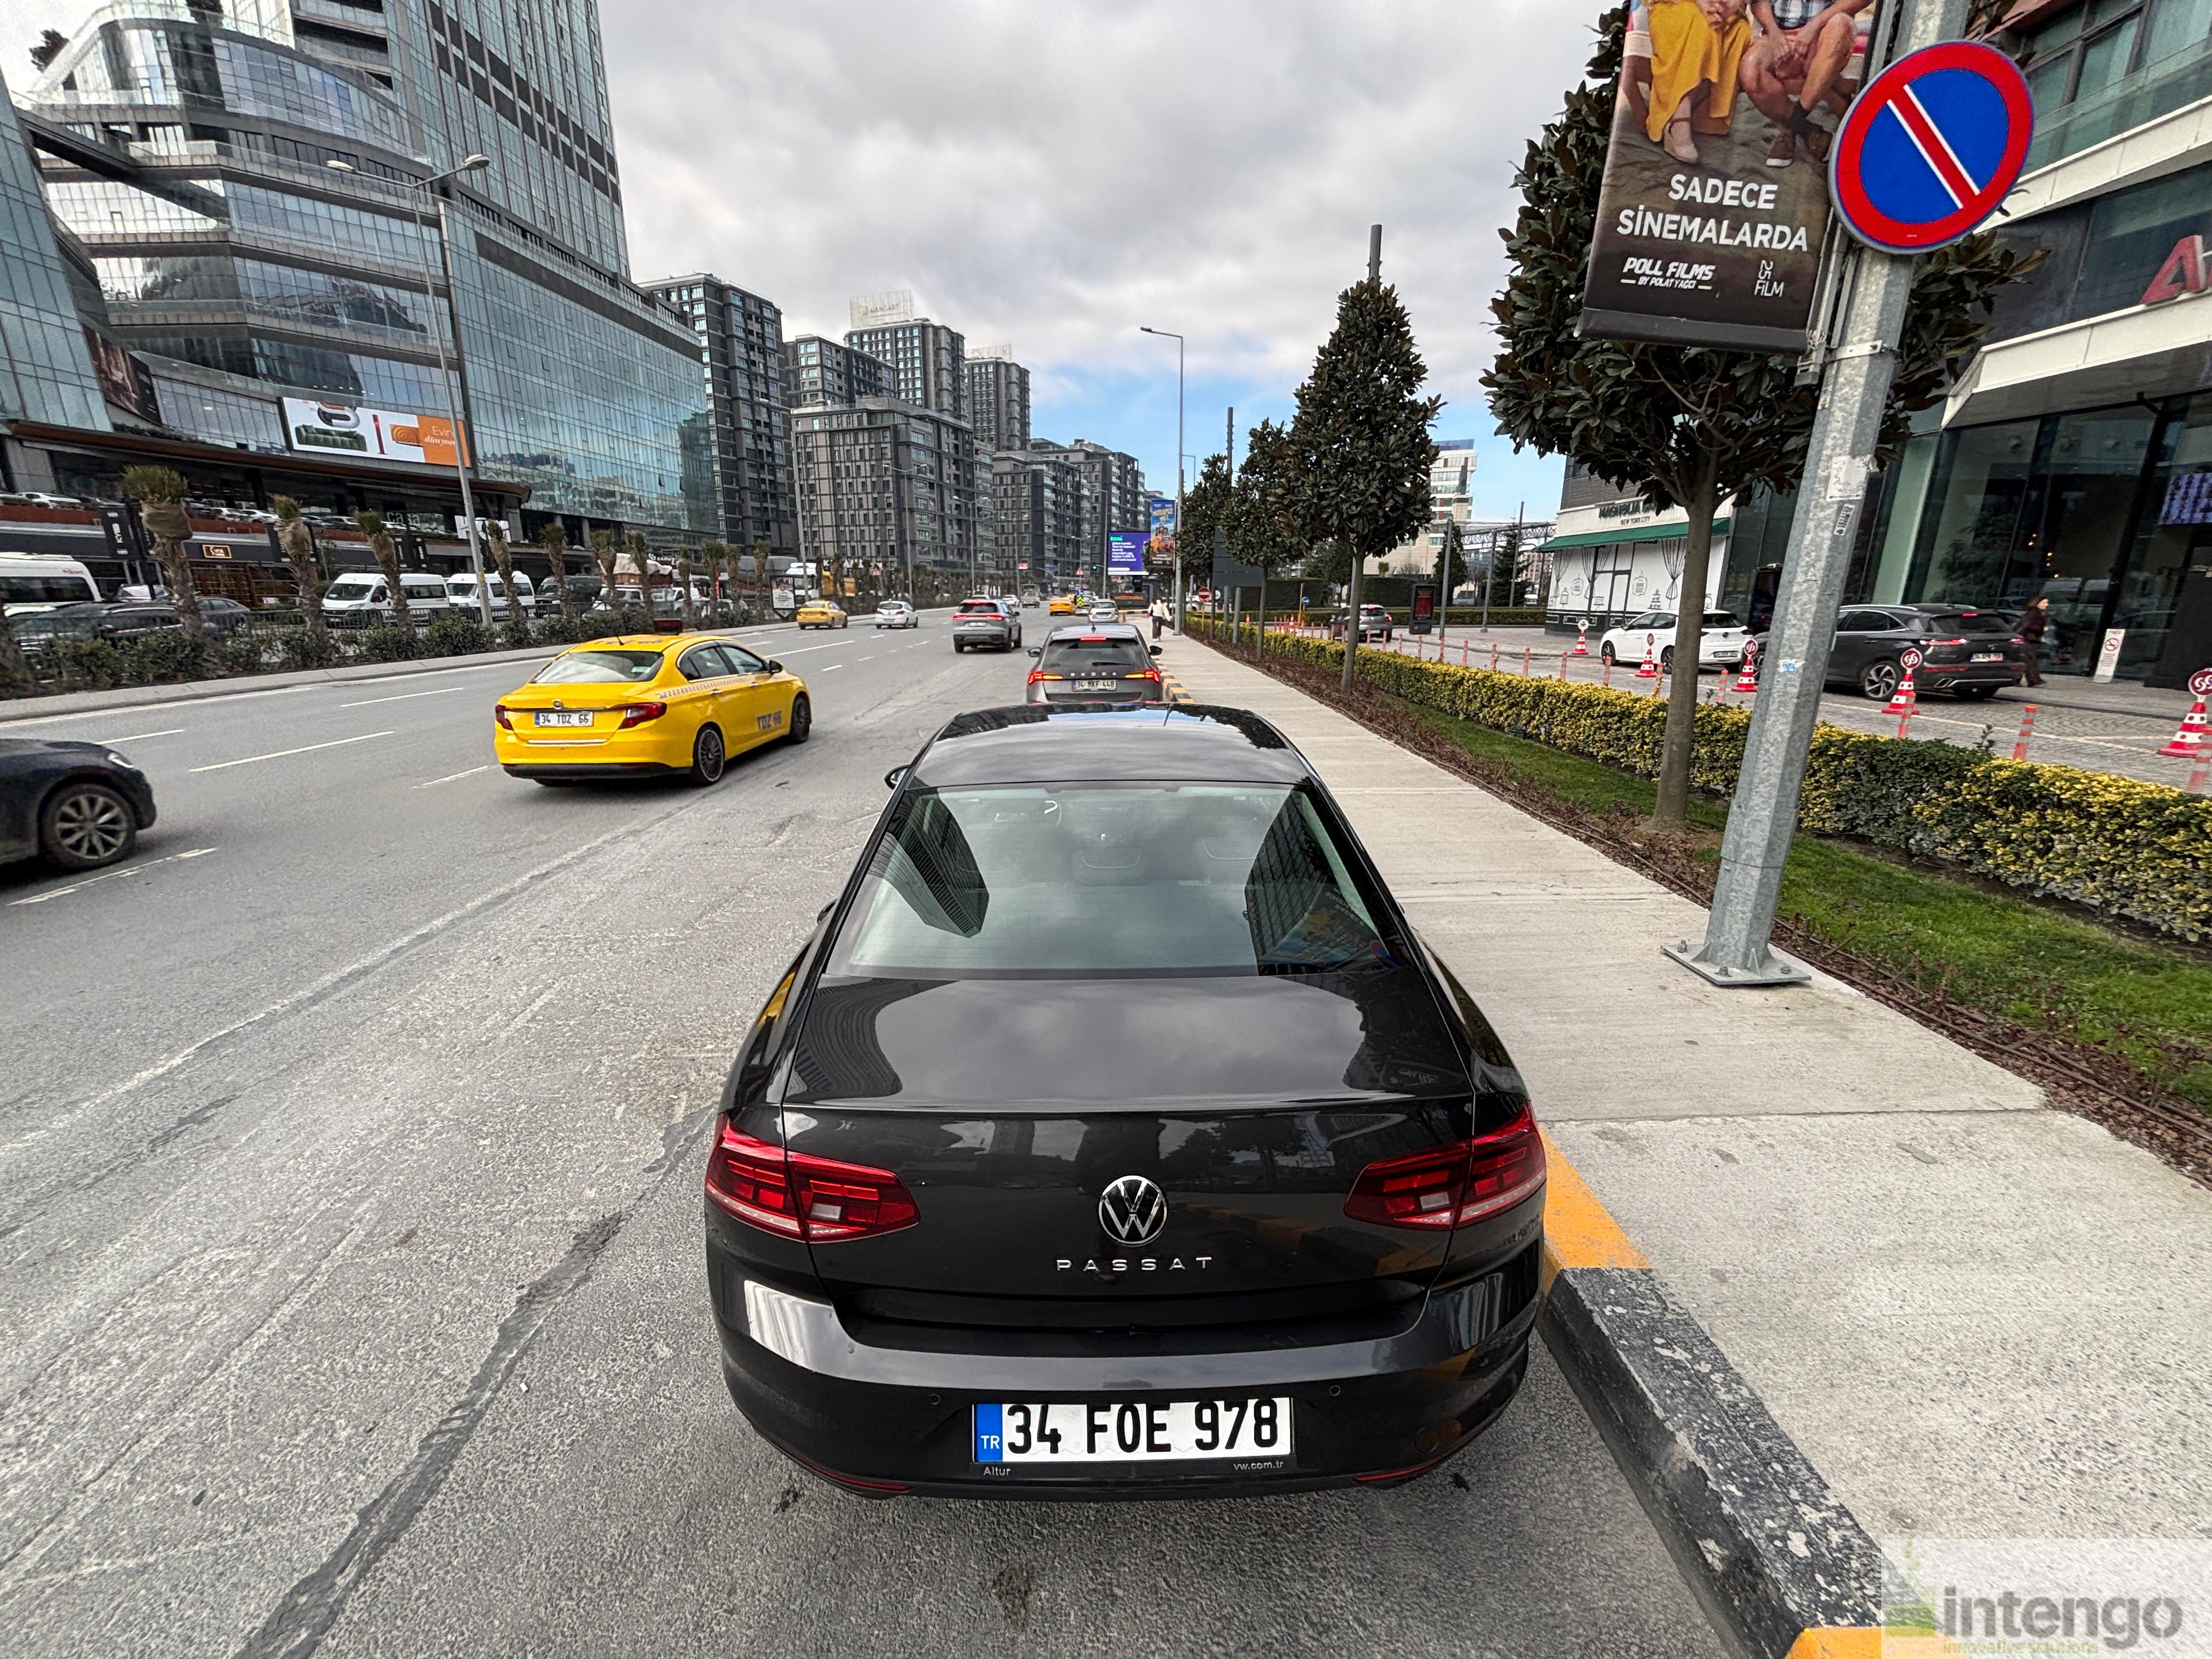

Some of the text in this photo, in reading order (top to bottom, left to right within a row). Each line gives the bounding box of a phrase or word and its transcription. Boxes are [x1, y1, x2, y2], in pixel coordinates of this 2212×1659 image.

[1668, 174, 1779, 210] SADECE
[1617, 204, 1808, 252] SİNEMALARDA
[1622, 257, 1717, 281] POLL FILMS
[2139, 235, 2212, 304] A
[1638, 276, 1649, 286] BY
[1649, 278, 1674, 288] POLAT
[869, 303, 900, 314] AVANGART
[539, 713, 589, 725] 34 TDZ 66
[757, 713, 772, 731] TDZ
[1056, 1256, 1213, 1272] PASSAT
[1007, 1398, 1278, 1455] 34 FOE 978
[980, 1435, 1001, 1449] TR
[983, 1466, 1011, 1478] Altur
[1232, 1458, 1284, 1471] vw.com.tr
